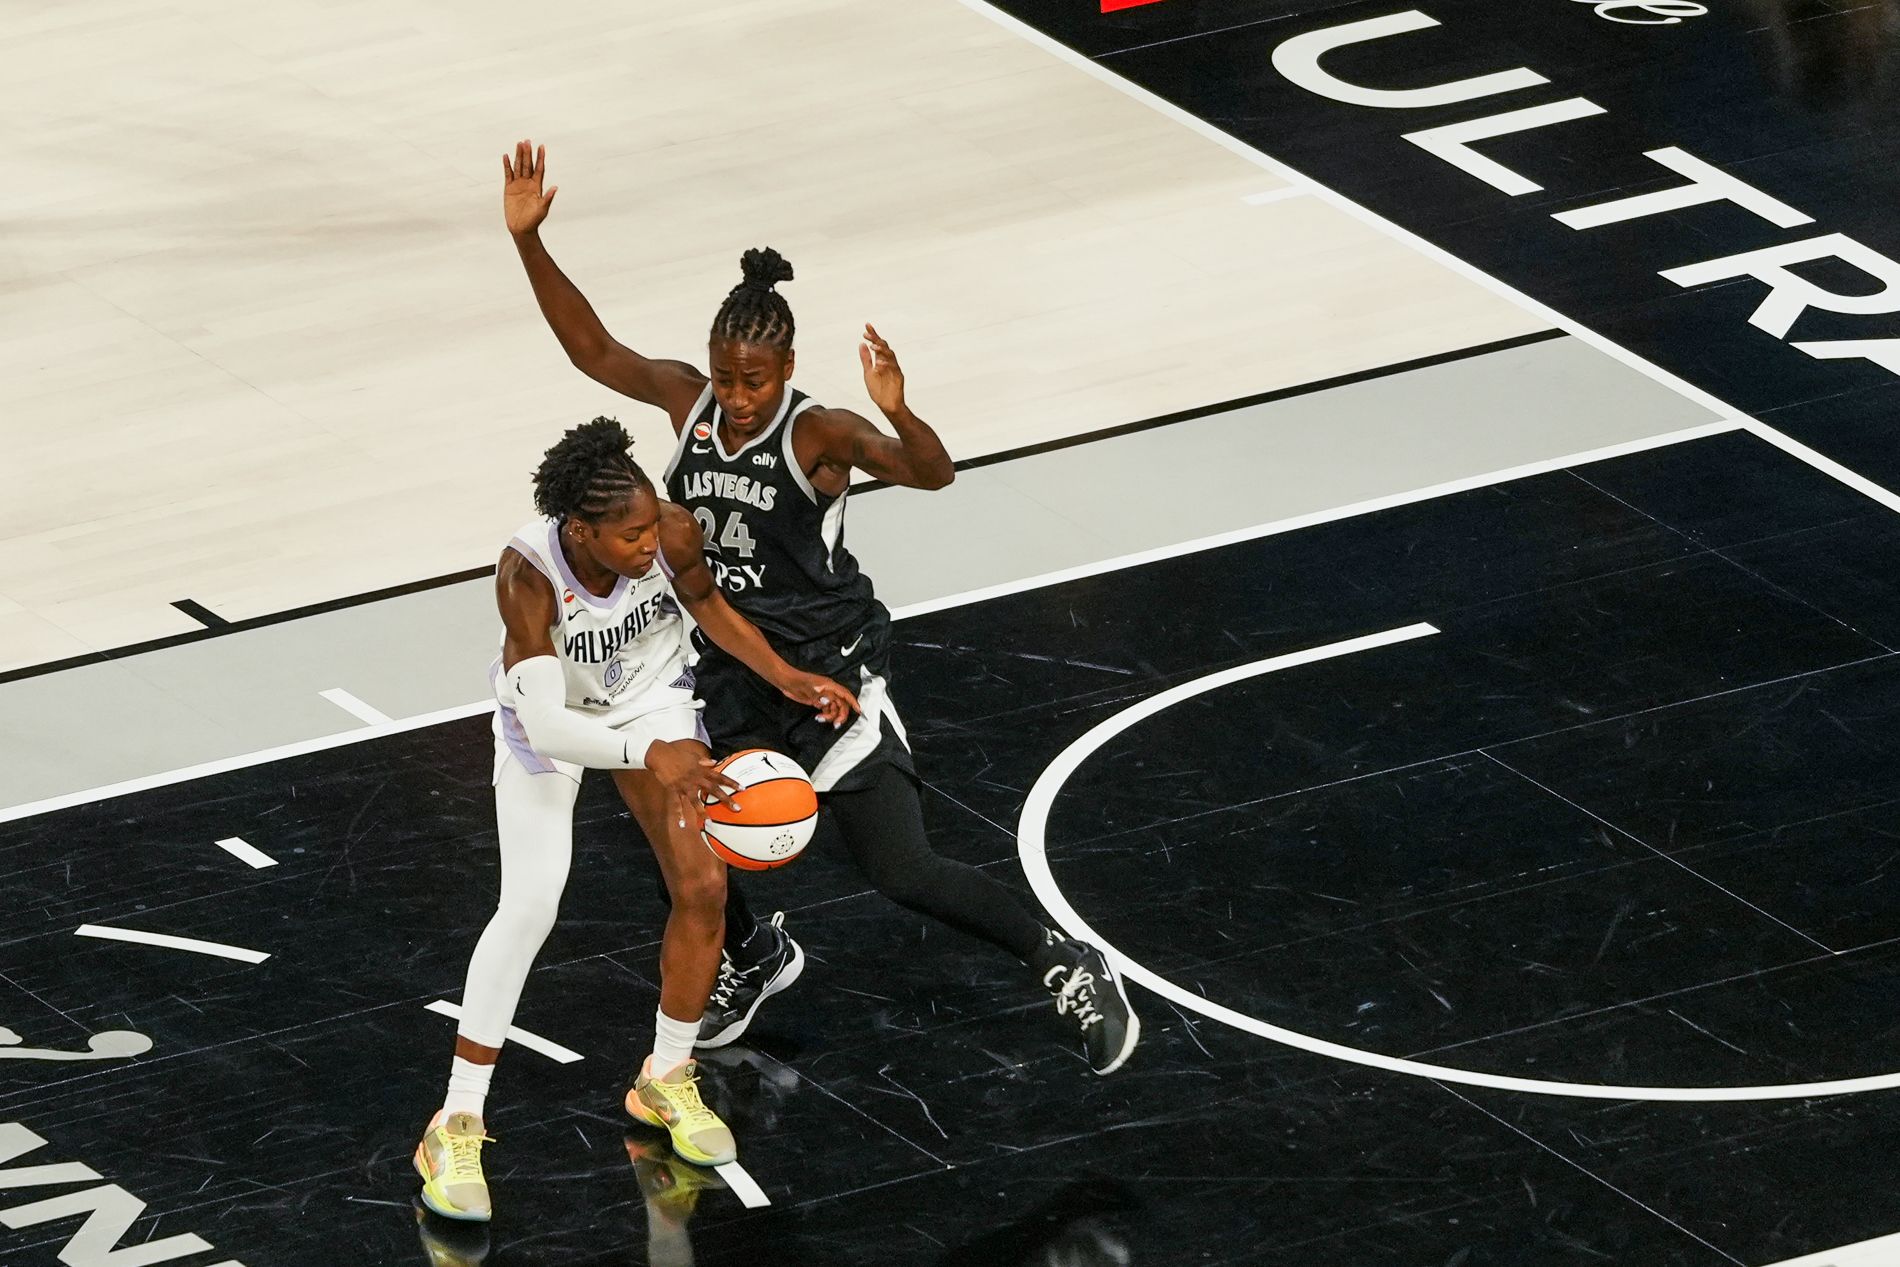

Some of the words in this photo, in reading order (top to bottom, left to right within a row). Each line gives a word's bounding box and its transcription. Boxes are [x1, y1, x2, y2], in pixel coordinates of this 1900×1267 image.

[752, 452, 778, 469] ally
[693, 506, 756, 558] 24
[563, 591, 662, 664] VALKYRIES
